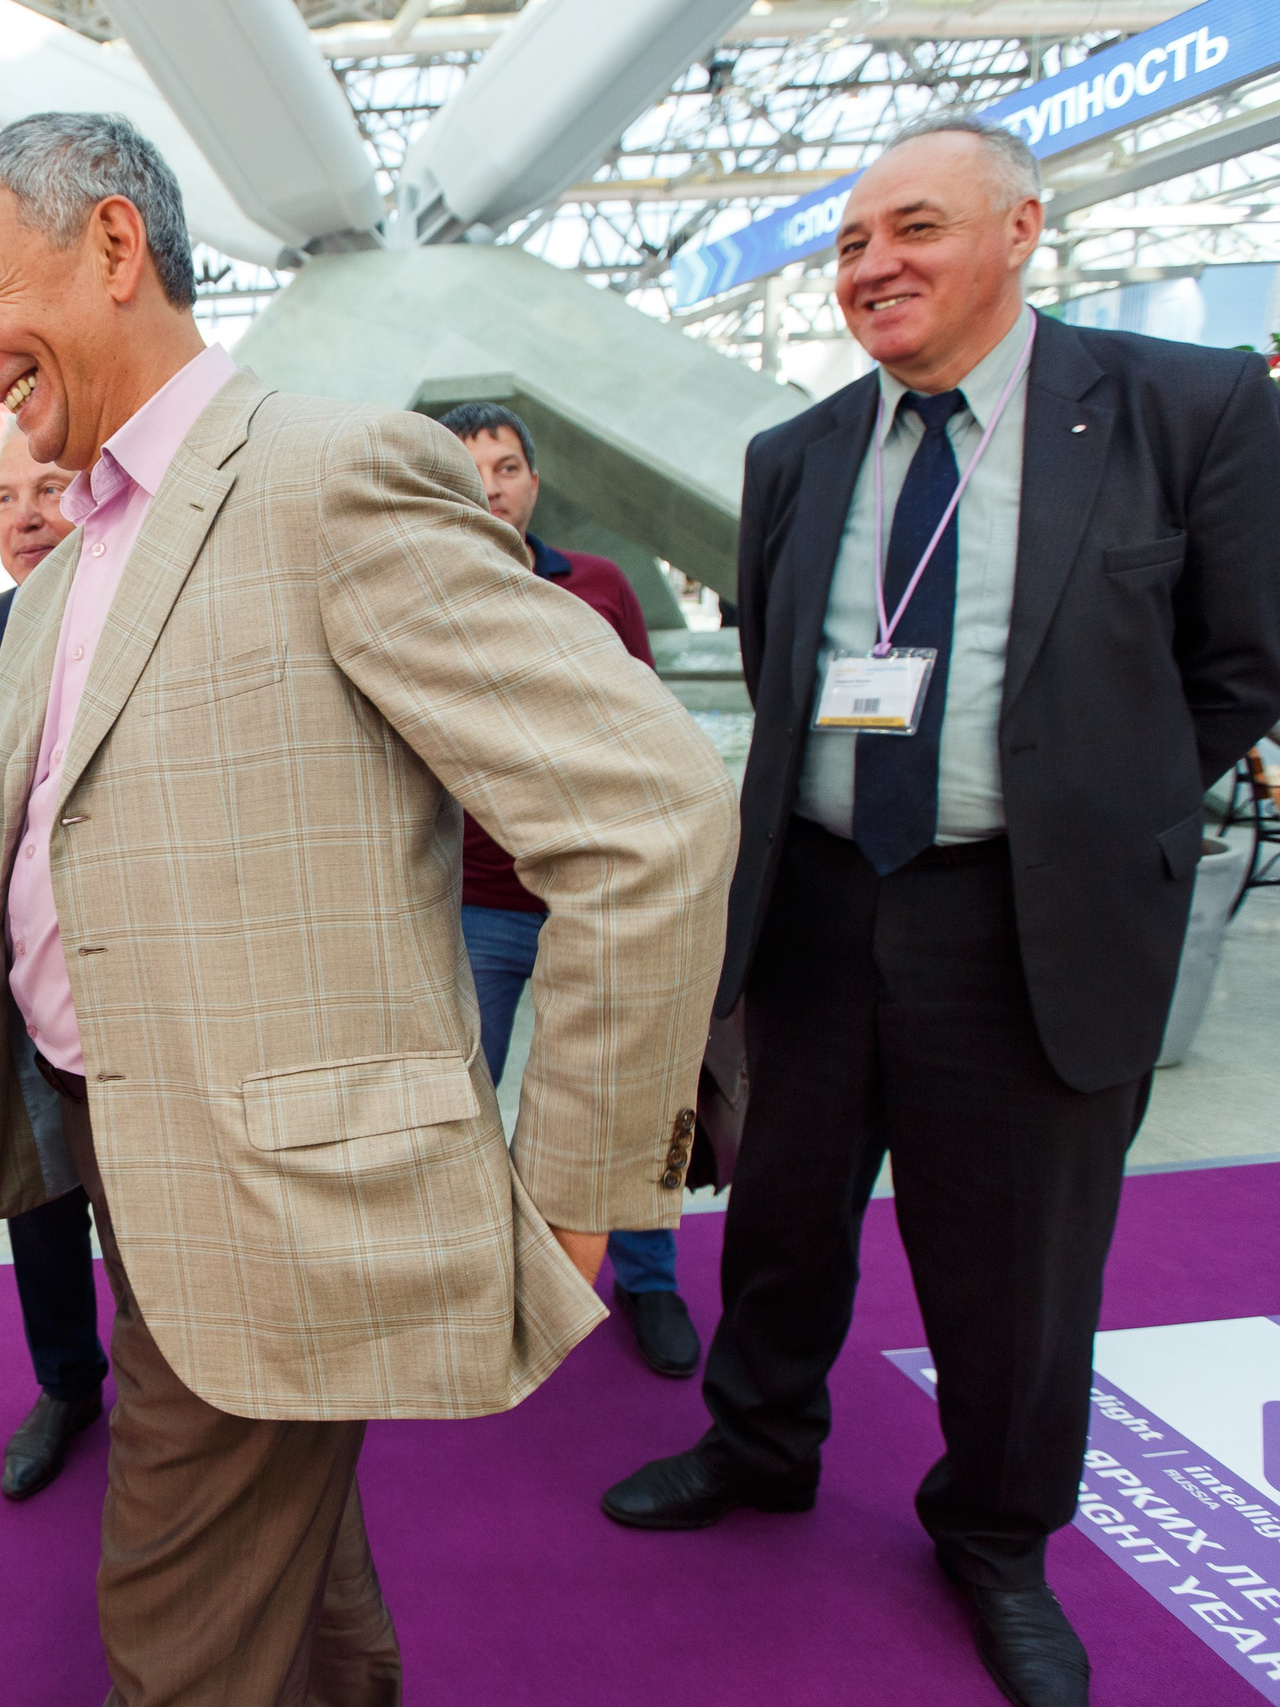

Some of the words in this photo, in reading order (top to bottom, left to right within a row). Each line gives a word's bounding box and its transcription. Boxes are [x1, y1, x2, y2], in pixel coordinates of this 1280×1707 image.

[1077, 1481, 1182, 1568] IGHT
[1089, 1387, 1165, 1442] light
[1182, 1465, 1280, 1543] intellig
[1161, 1468, 1221, 1511] RUSSIA
[1083, 1449, 1227, 1555] ЯРКИХ
[1205, 1562, 1280, 1625] ЛЕ
